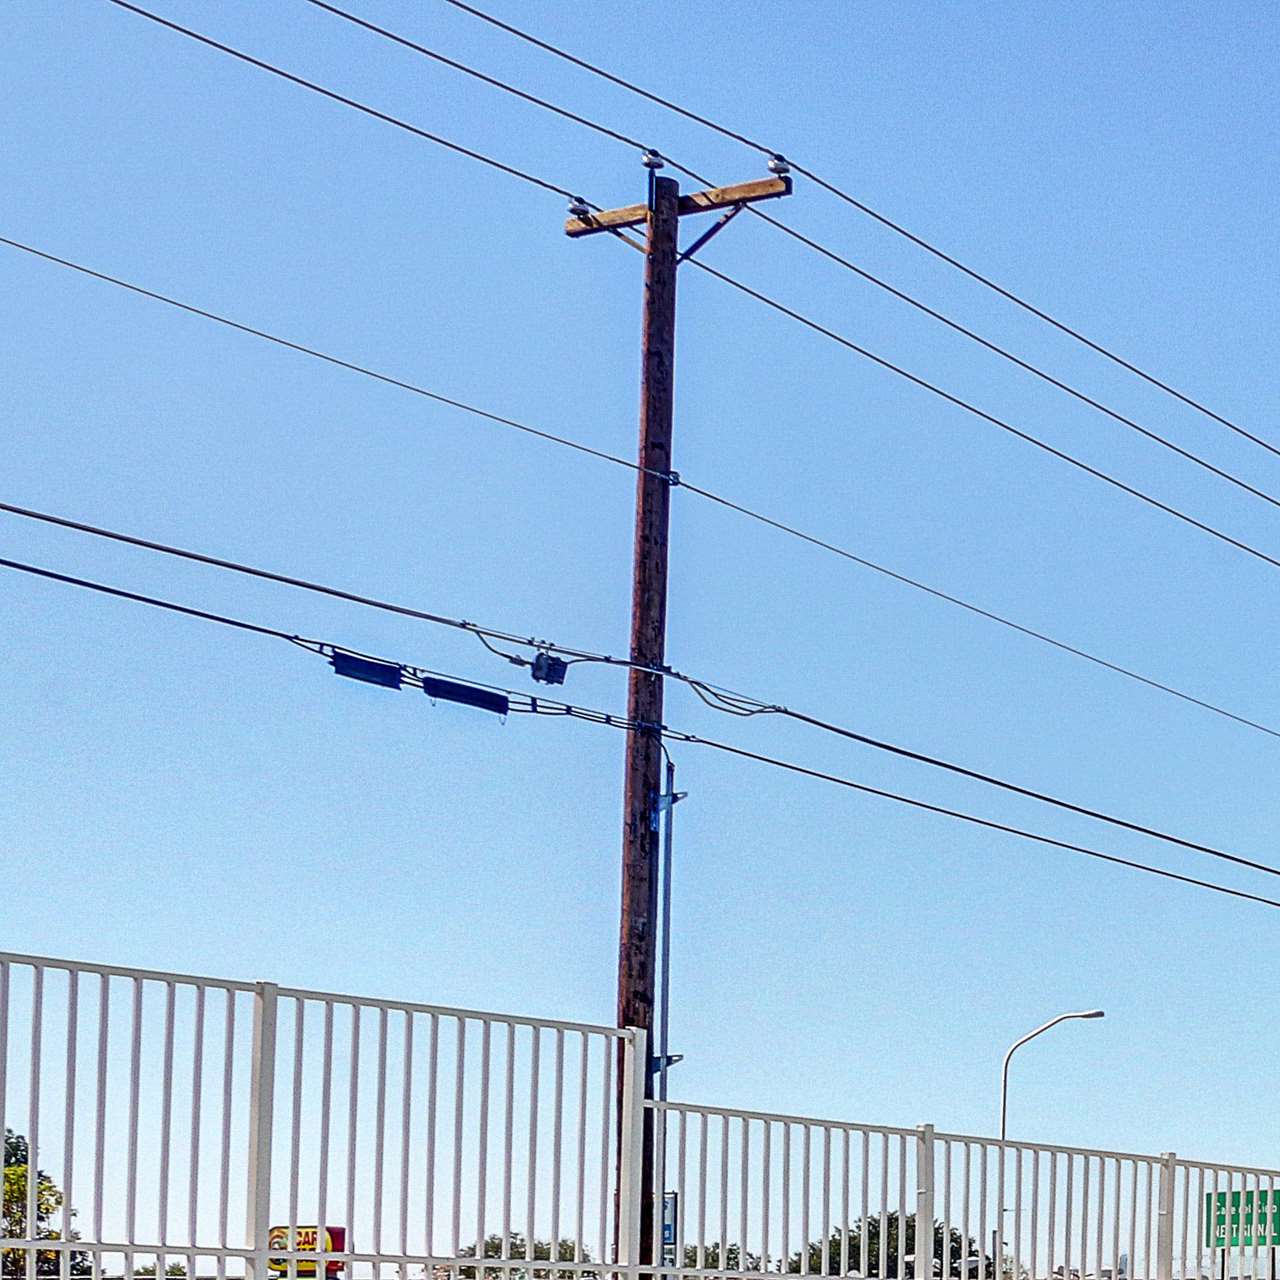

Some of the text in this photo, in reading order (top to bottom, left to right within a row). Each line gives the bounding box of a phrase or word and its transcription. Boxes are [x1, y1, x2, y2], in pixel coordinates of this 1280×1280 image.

[1213, 1202, 1237, 1214] Cae
[1254, 1200, 1278, 1213] Cio
[1214, 1224, 1238, 1237] NET
